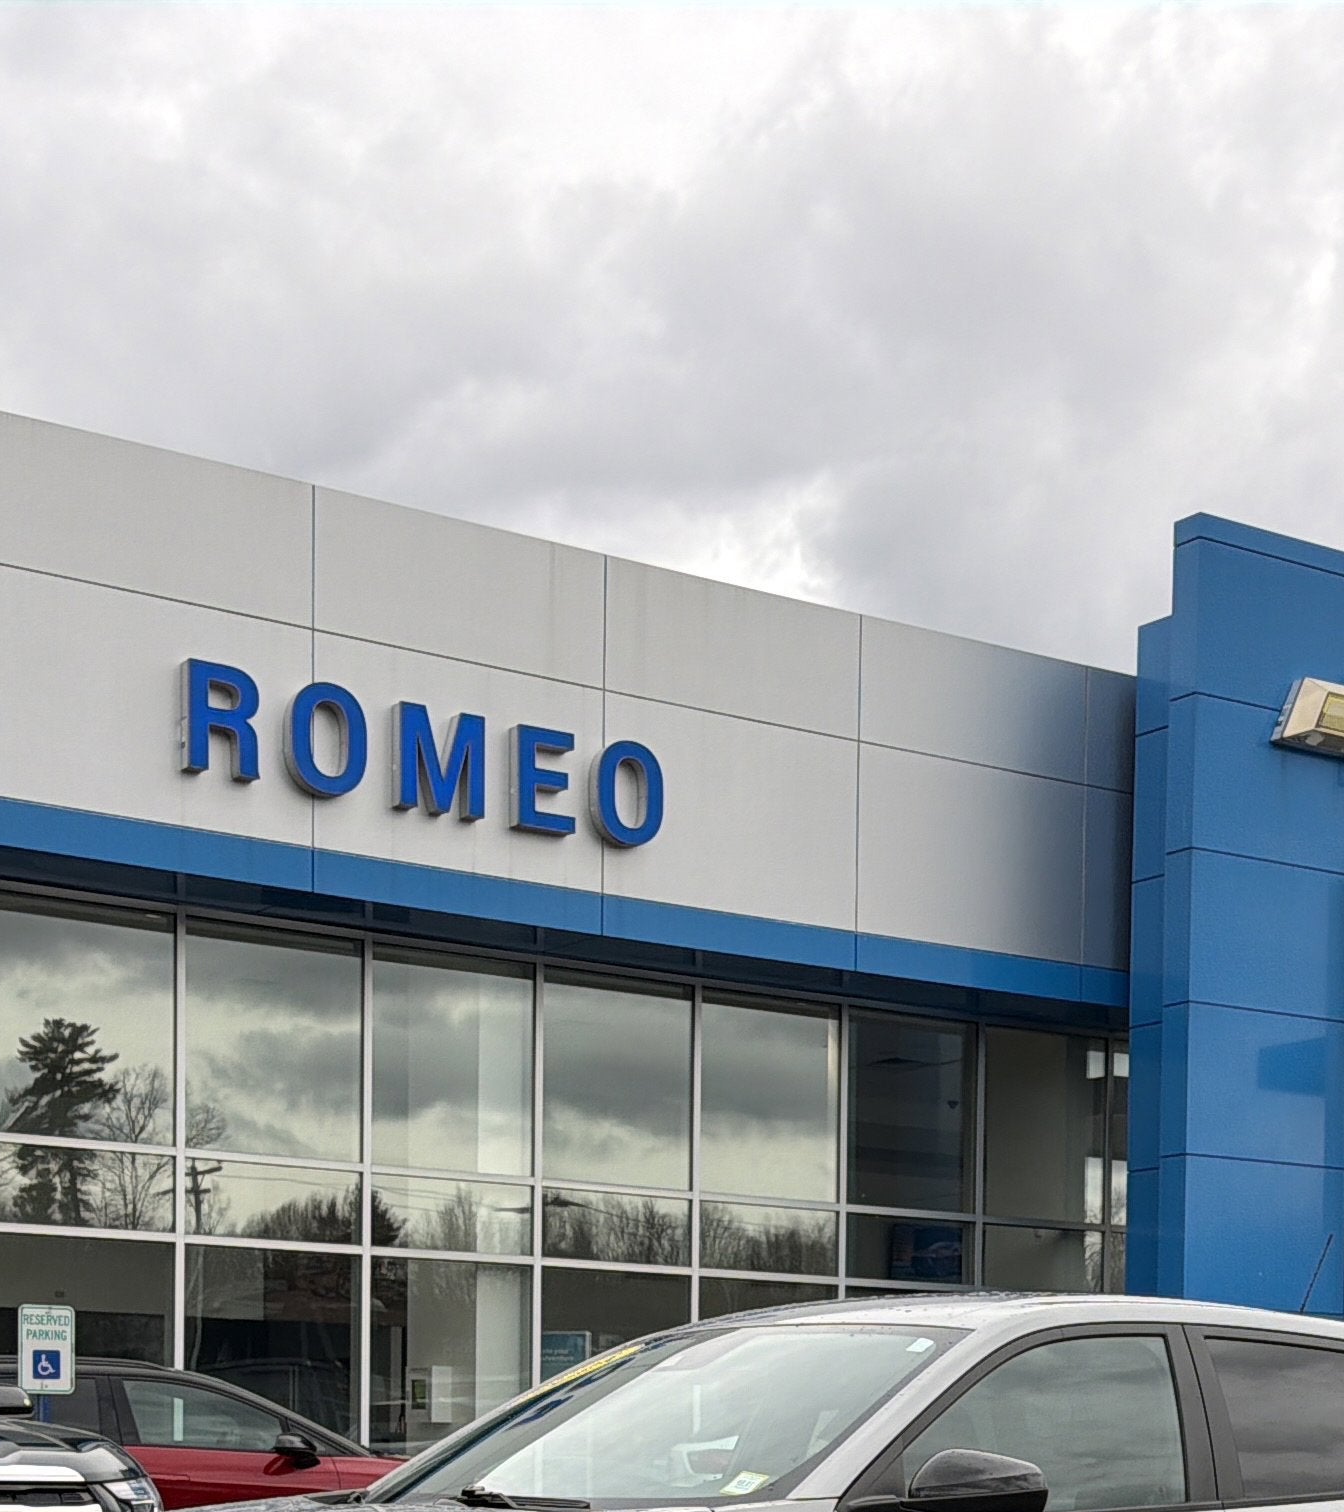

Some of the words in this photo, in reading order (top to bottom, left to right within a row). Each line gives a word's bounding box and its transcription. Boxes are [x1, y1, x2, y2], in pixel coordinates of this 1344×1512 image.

[181, 658, 664, 848] ROMEO
[22, 1313, 71, 1327] RESERVED
[26, 1328, 68, 1341] PARKING
